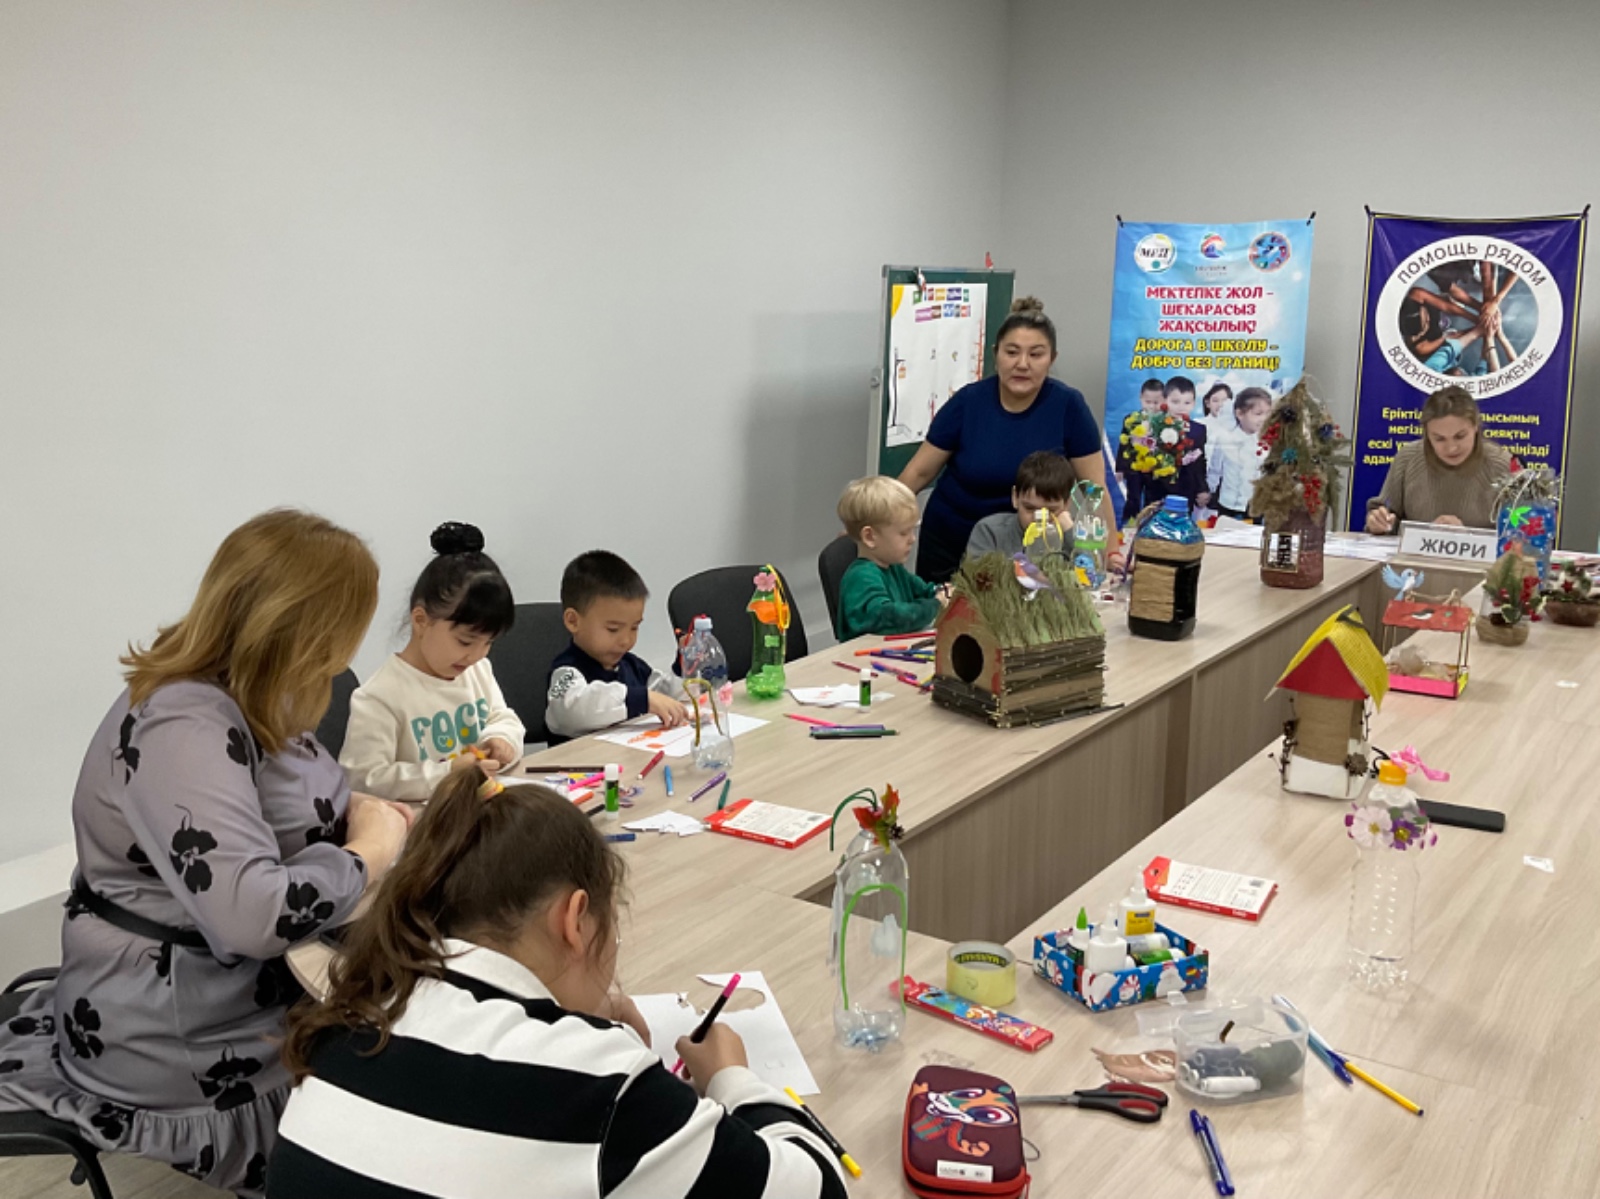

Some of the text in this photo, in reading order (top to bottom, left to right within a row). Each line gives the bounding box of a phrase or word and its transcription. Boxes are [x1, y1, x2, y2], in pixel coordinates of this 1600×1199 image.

[1146, 286, 1222, 299] МЕКТЕПКЕ
[1226, 286, 1263, 299] ЖОЛ
[1161, 303, 1256, 316] ШЕКАРАСЫЗ
[1134, 338, 1194, 353] ДОРОГА
[1196, 338, 1207, 352] В
[1131, 355, 1182, 369] ДОБРО
[1185, 355, 1213, 369] БЕЗ
[1478, 347, 1544, 394] ДВИЖЕНИЕ
[1483, 429, 1530, 440] сияқты
[1419, 537, 1487, 558] ЖЮРИ
